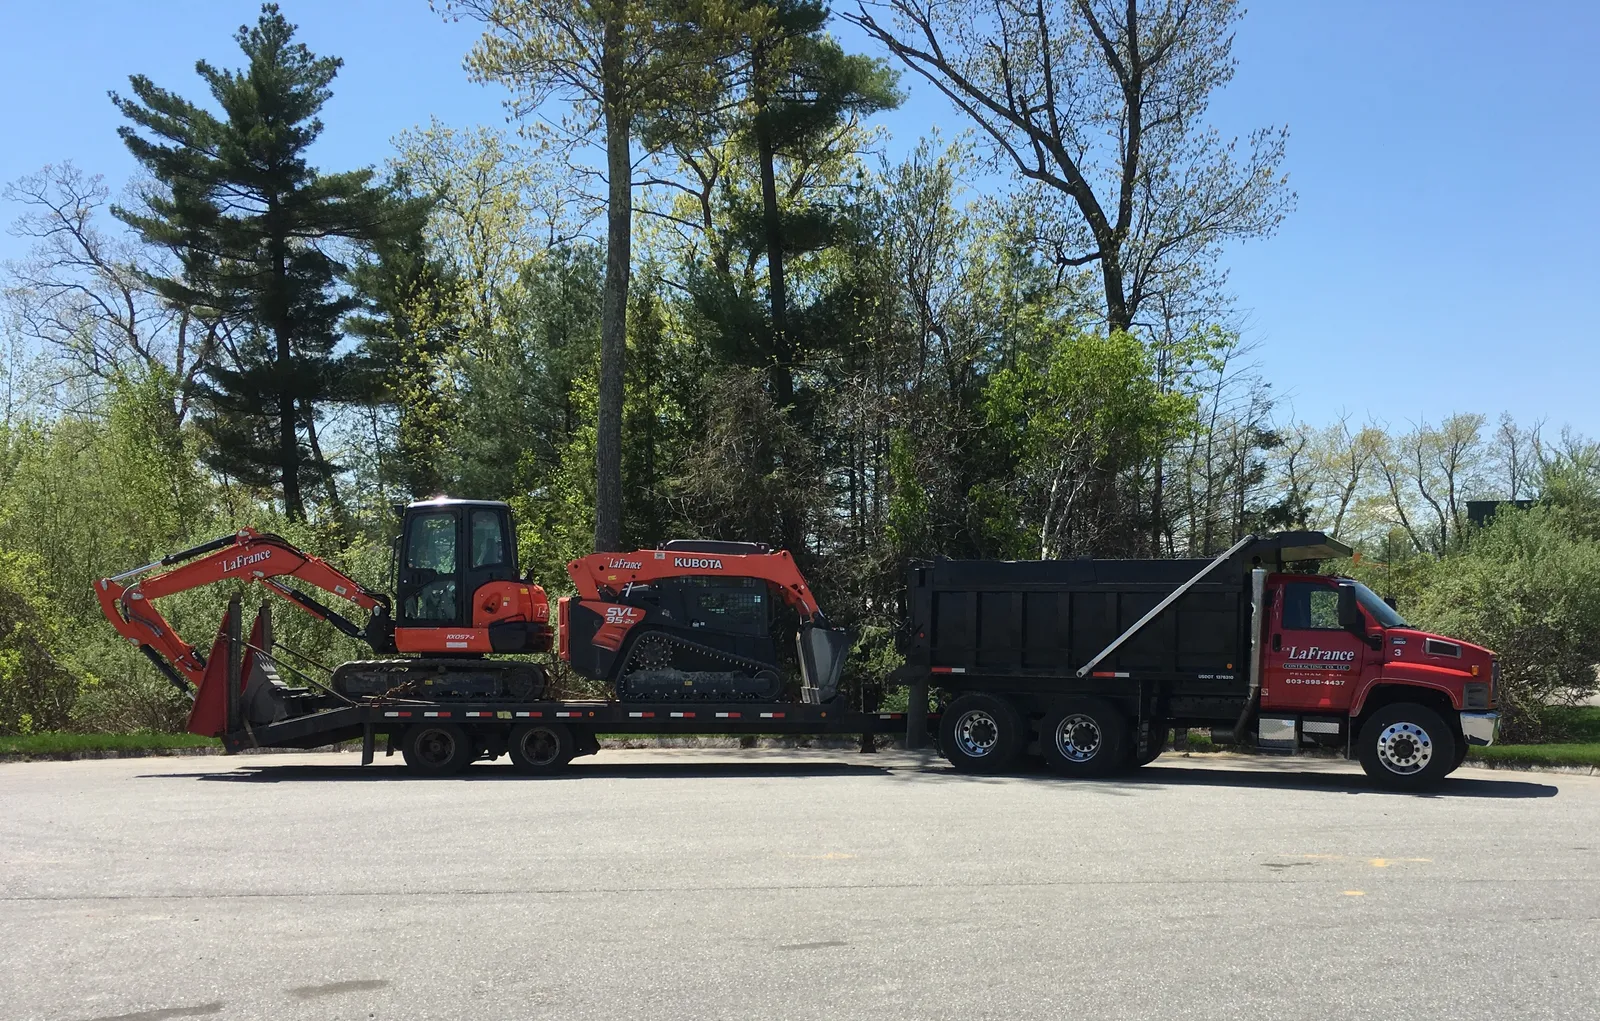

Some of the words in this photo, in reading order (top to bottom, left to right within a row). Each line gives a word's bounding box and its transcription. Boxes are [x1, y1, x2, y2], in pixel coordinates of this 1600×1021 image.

[222, 549, 272, 573] LaFrance
[608, 558, 642, 570] LaFrance
[674, 557, 722, 569] KUBOTA
[605, 607, 638, 617] SVL
[1289, 646, 1355, 661] LaFrance
[1394, 648, 1401, 657] 3
